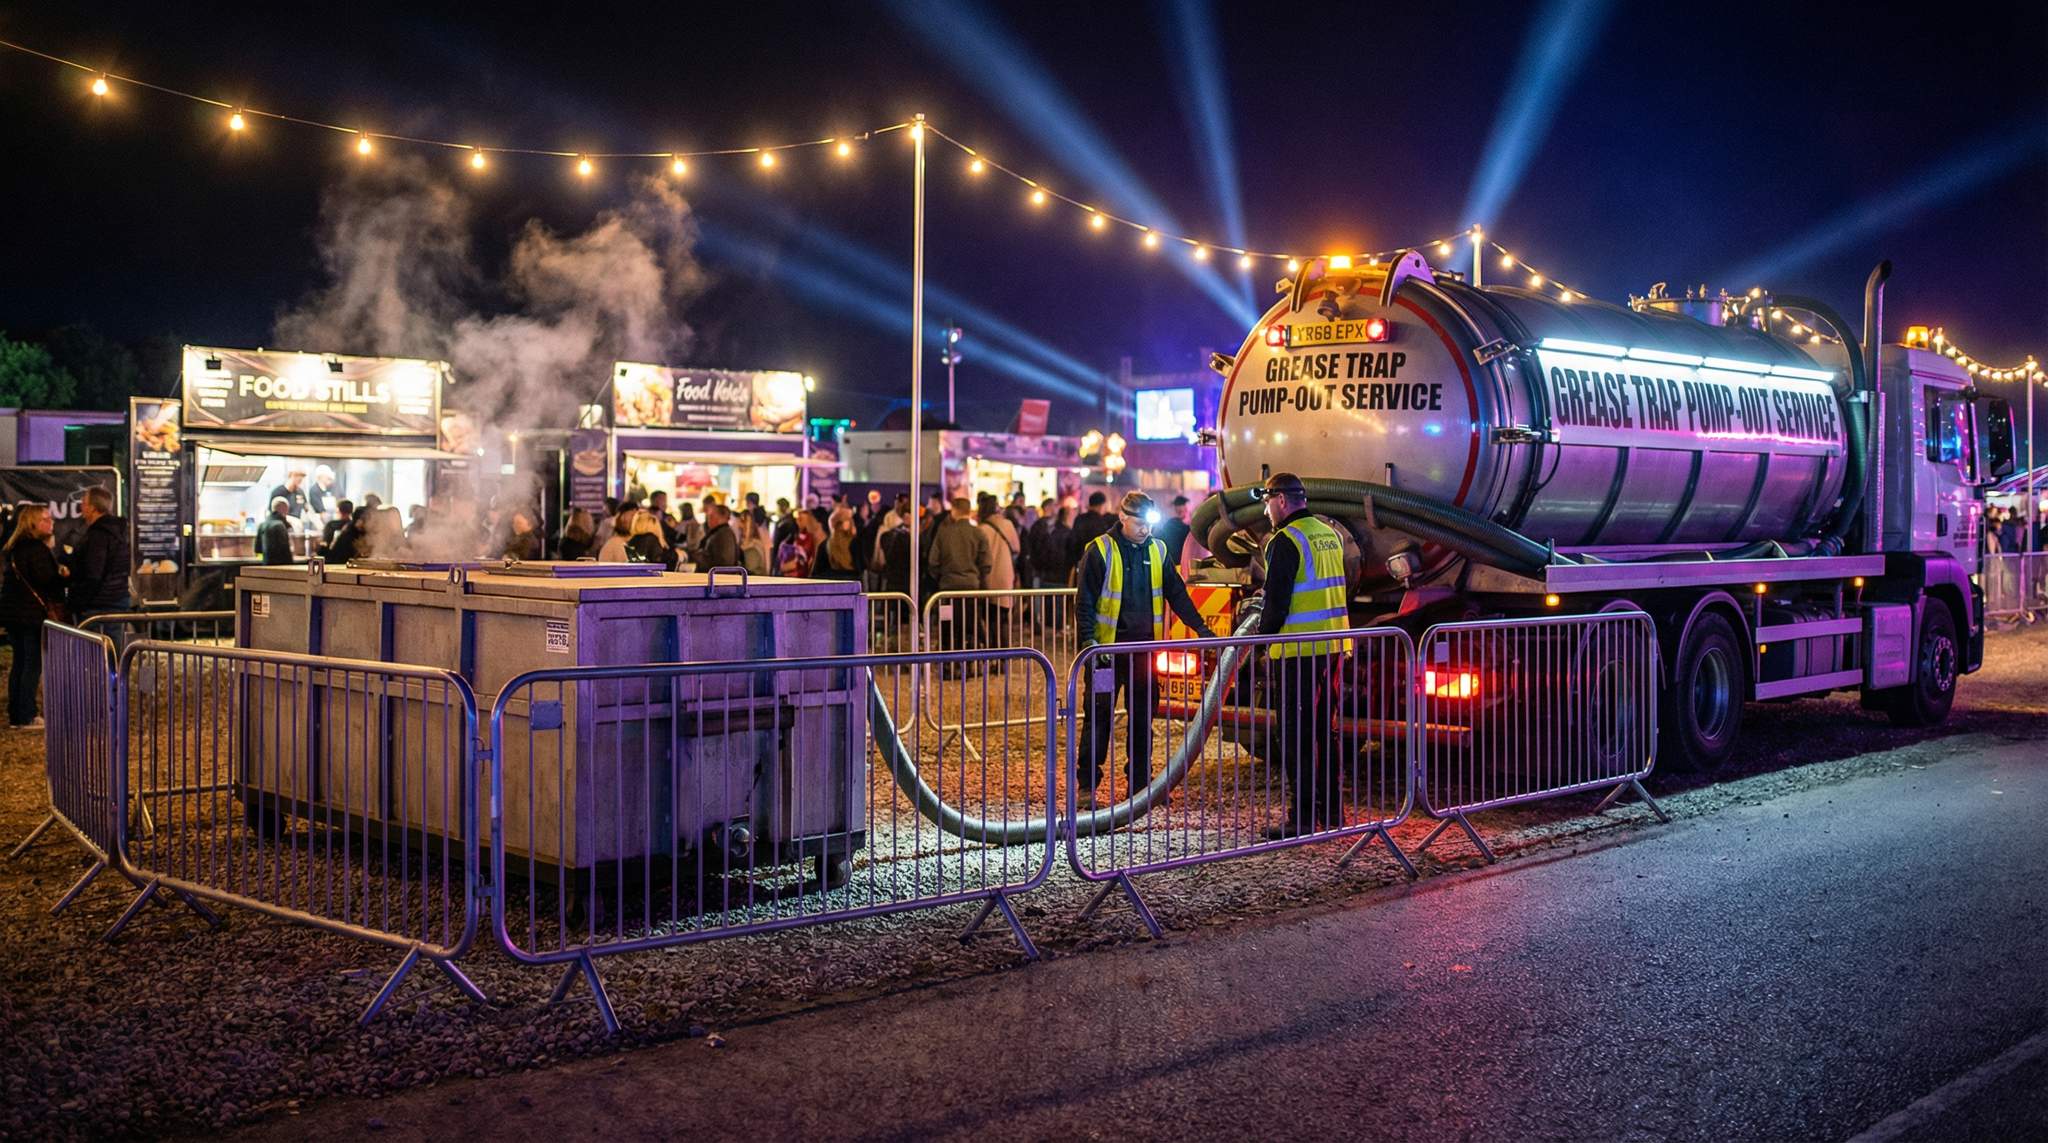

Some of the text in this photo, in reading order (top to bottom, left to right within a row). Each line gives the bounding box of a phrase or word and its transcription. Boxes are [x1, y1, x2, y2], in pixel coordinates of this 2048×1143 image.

[1297, 323, 1364, 341] YR68 EPX
[1266, 352, 1406, 382] GREASE TRAP
[239, 374, 310, 400] FOOD
[676, 376, 712, 400] Food
[1239, 383, 1442, 416] PUMP-OUT SERVICE
[1551, 366, 1839, 442] GREASE TRAP PUMP-OUT SERVICE
